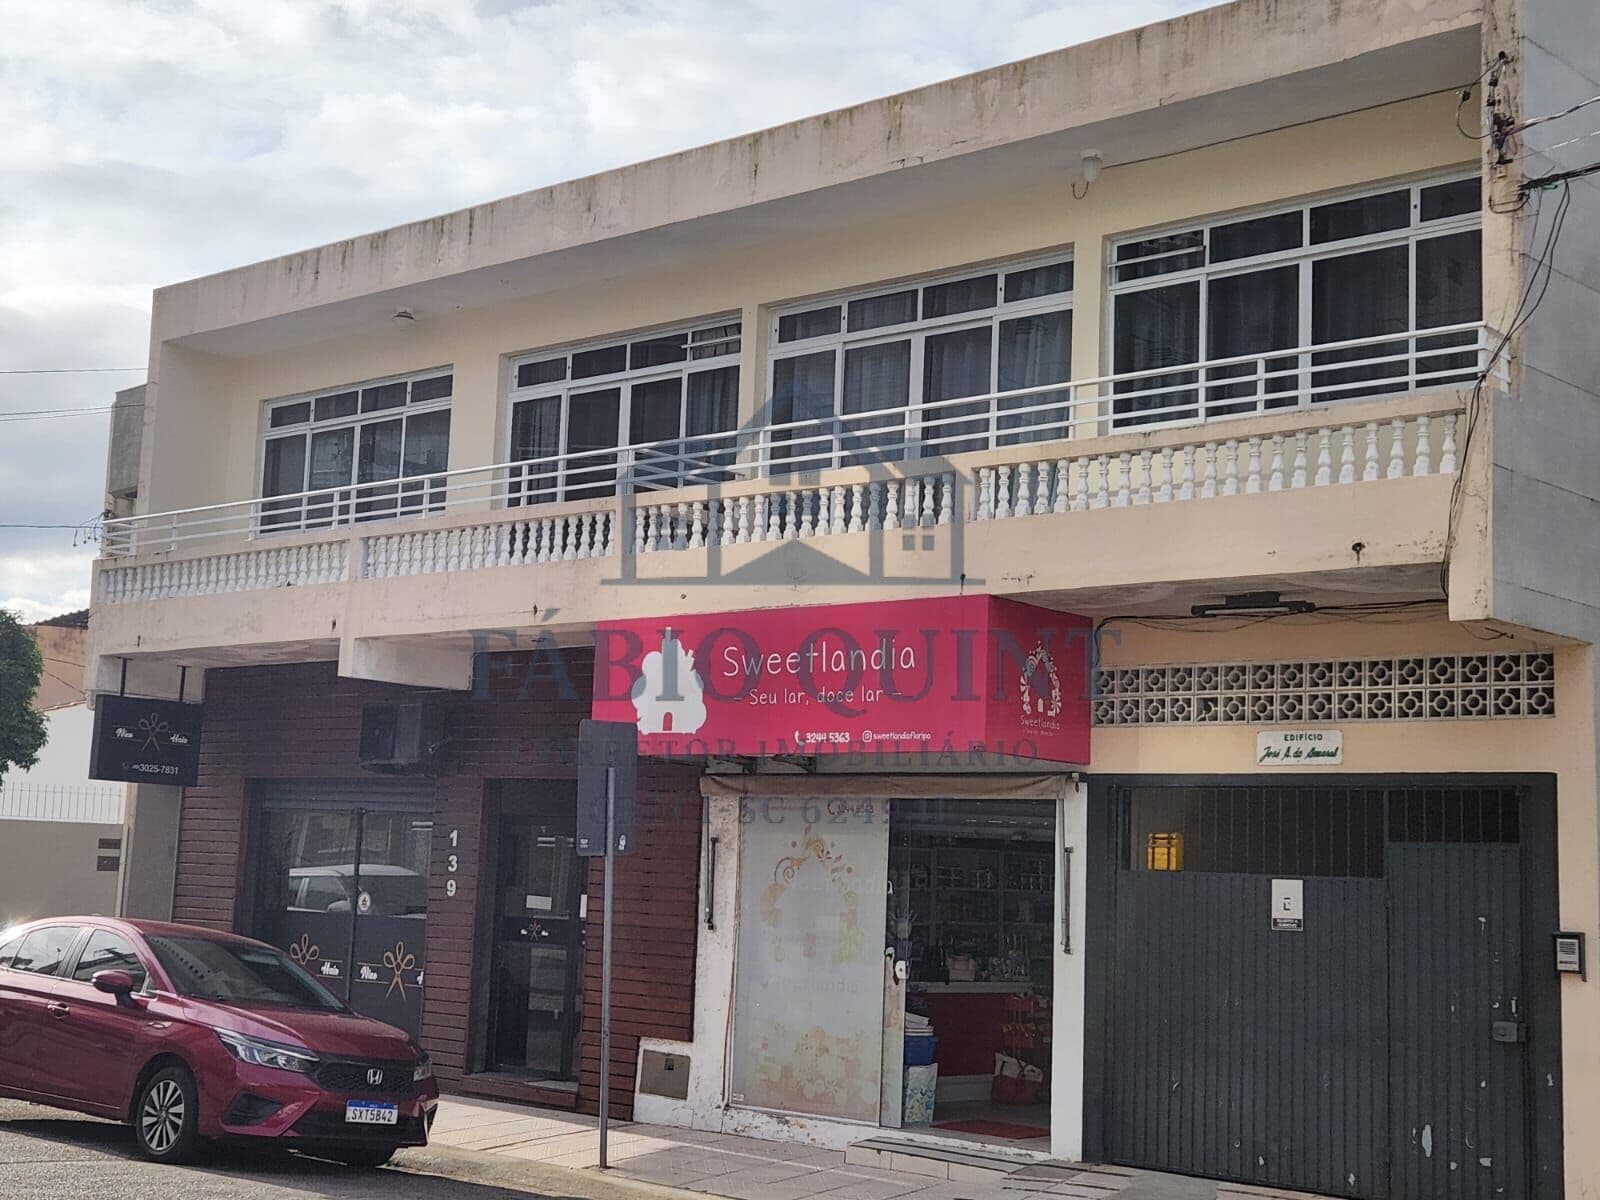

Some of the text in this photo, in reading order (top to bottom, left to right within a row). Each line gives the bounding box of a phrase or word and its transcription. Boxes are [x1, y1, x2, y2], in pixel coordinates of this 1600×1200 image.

[723, 638, 916, 677] Sweetlandia
[750, 685, 884, 705] Seu lar, doce lar
[829, 732, 850, 743] 5363
[352, 1109, 393, 1122] SXT5B42
